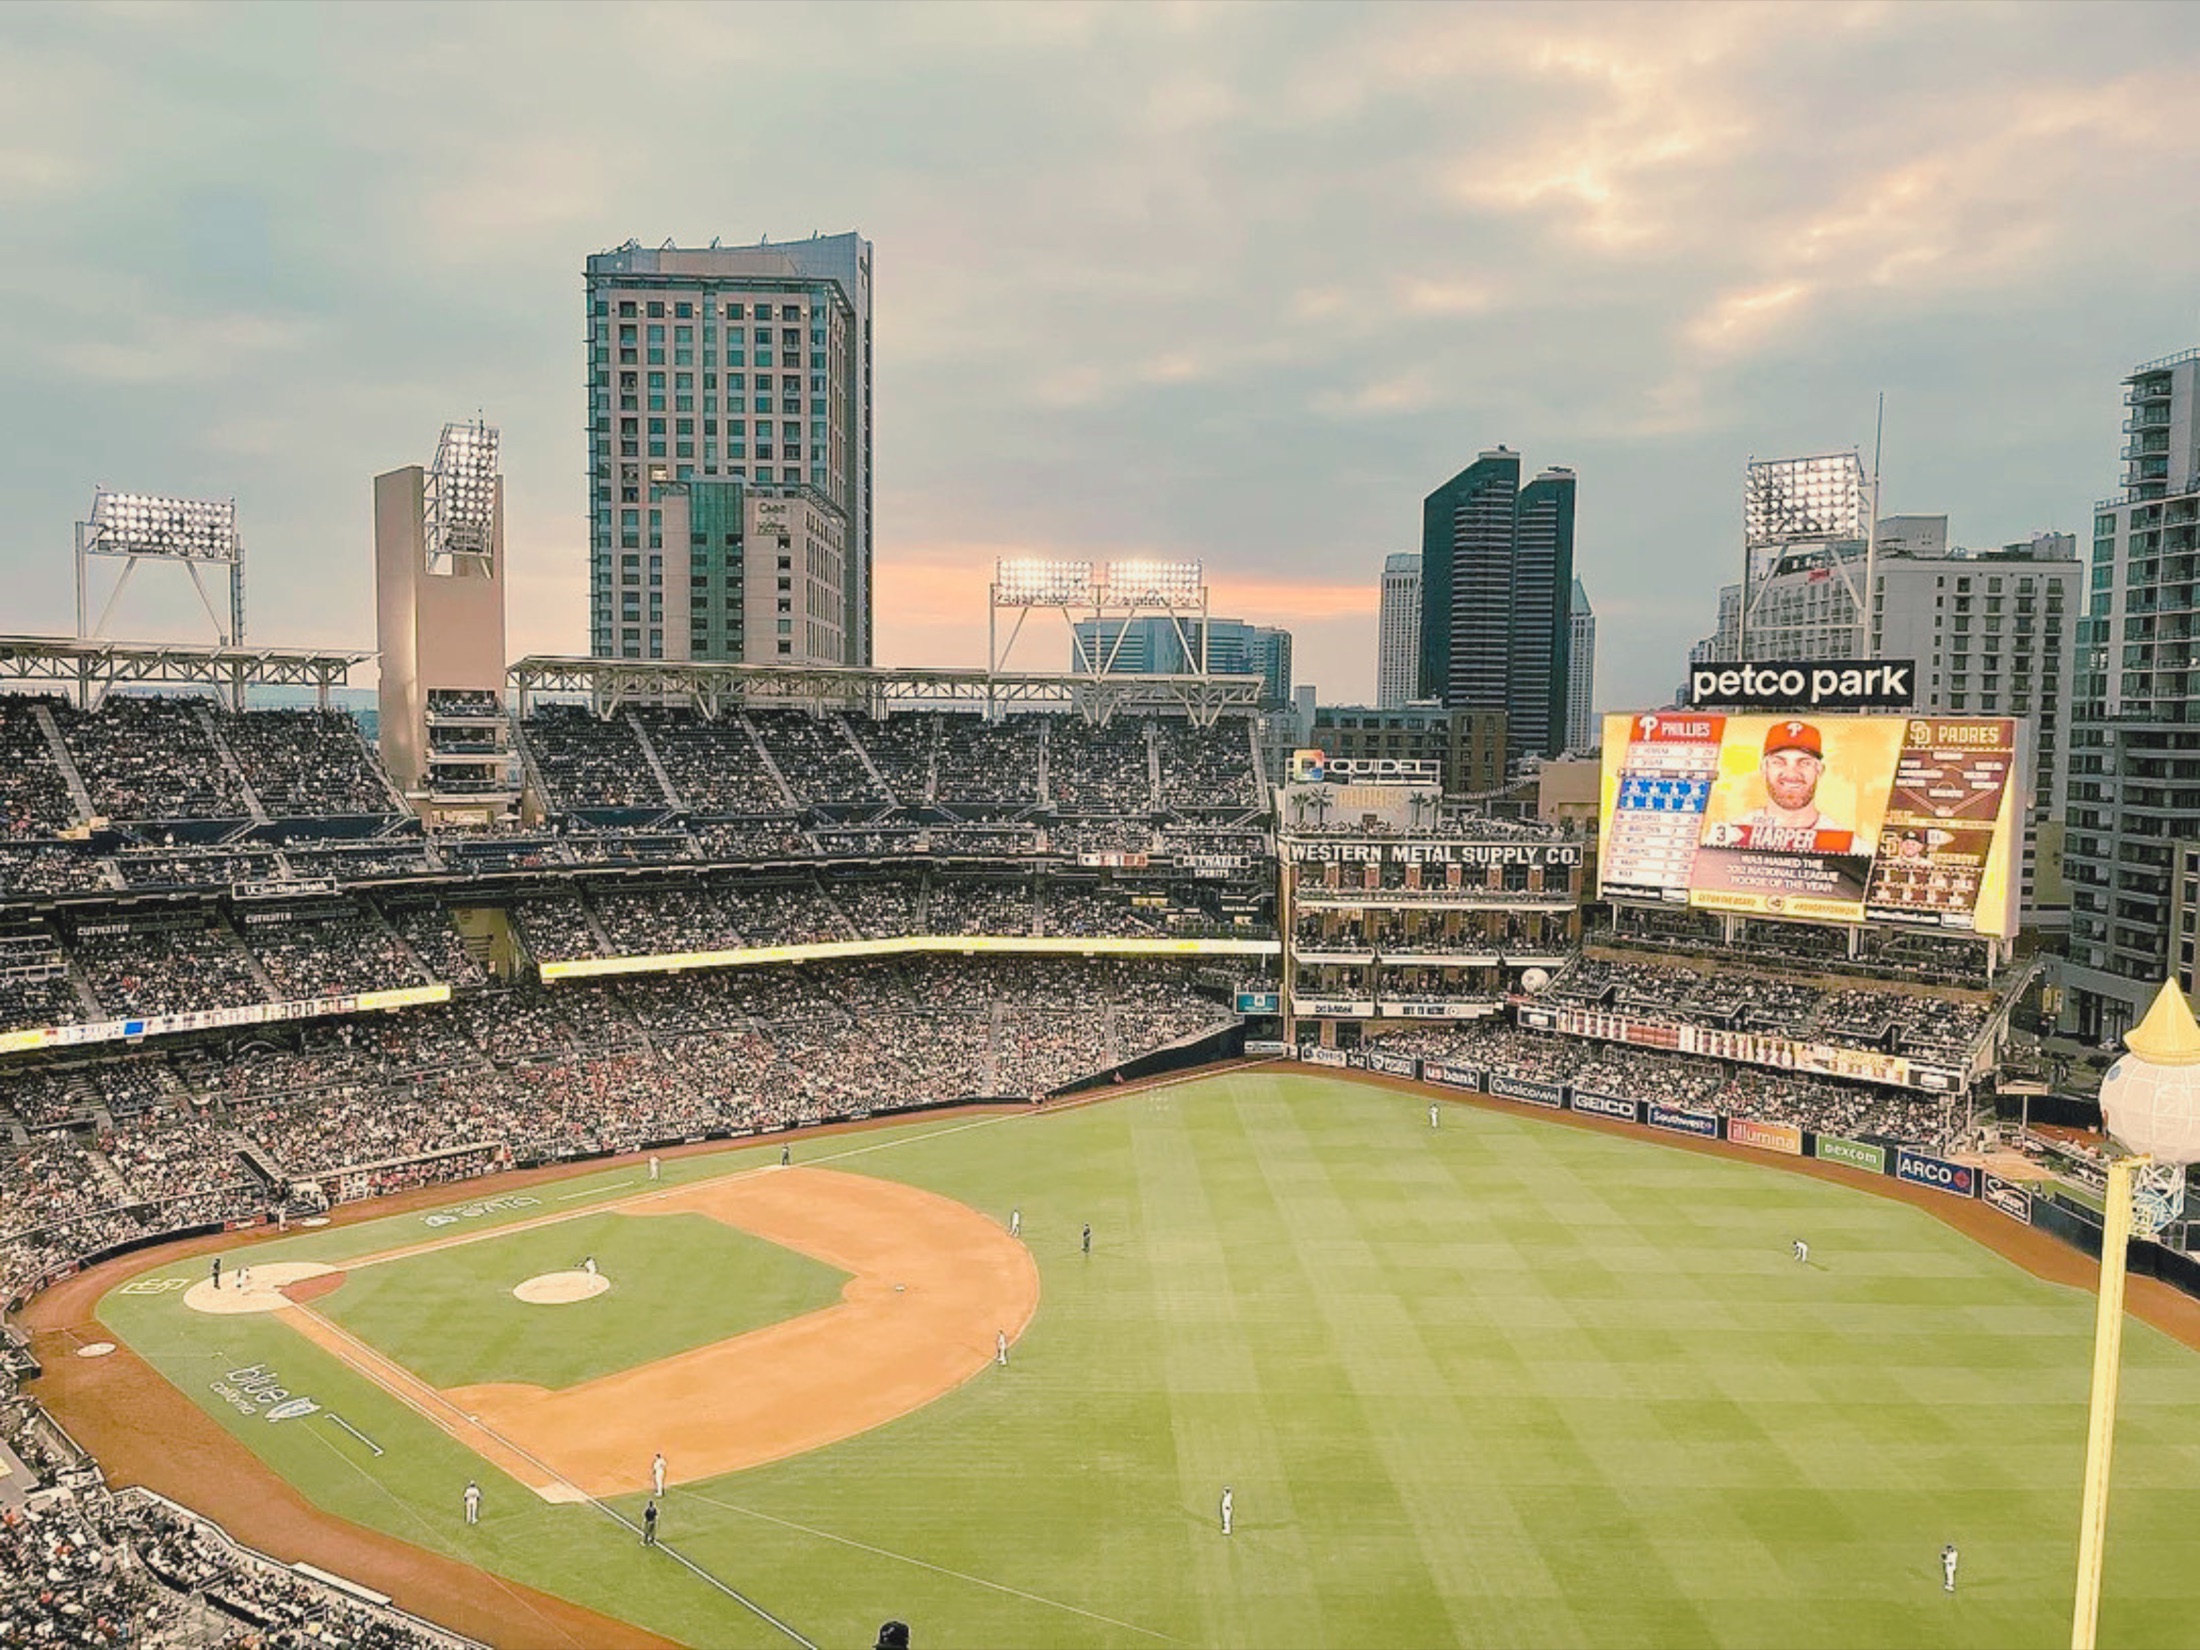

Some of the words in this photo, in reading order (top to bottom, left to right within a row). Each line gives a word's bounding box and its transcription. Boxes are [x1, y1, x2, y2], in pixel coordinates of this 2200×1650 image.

[1693, 664, 1805, 703] petco
[1811, 666, 1909, 703] park
[1661, 722, 1711, 737] PHILLIES
[1938, 725, 1999, 744] PADRES
[1330, 759, 1432, 775] QUIDEL
[1716, 825, 1726, 842] 3
[1750, 825, 1817, 850] HARPER
[1291, 844, 1382, 861] WESTERN
[1391, 845, 1457, 862] METAL
[1462, 846, 1538, 864] SUPPLY
[1546, 847, 1579, 864] CO.
[1492, 1079, 1558, 1103] Qualcomm
[1575, 1094, 1635, 1116] GEICO
[1653, 1111, 1706, 1130] Southwest
[1732, 1123, 1796, 1149] illumina
[1900, 1158, 1952, 1184] ARCO
[225, 1364, 290, 1402] blue
